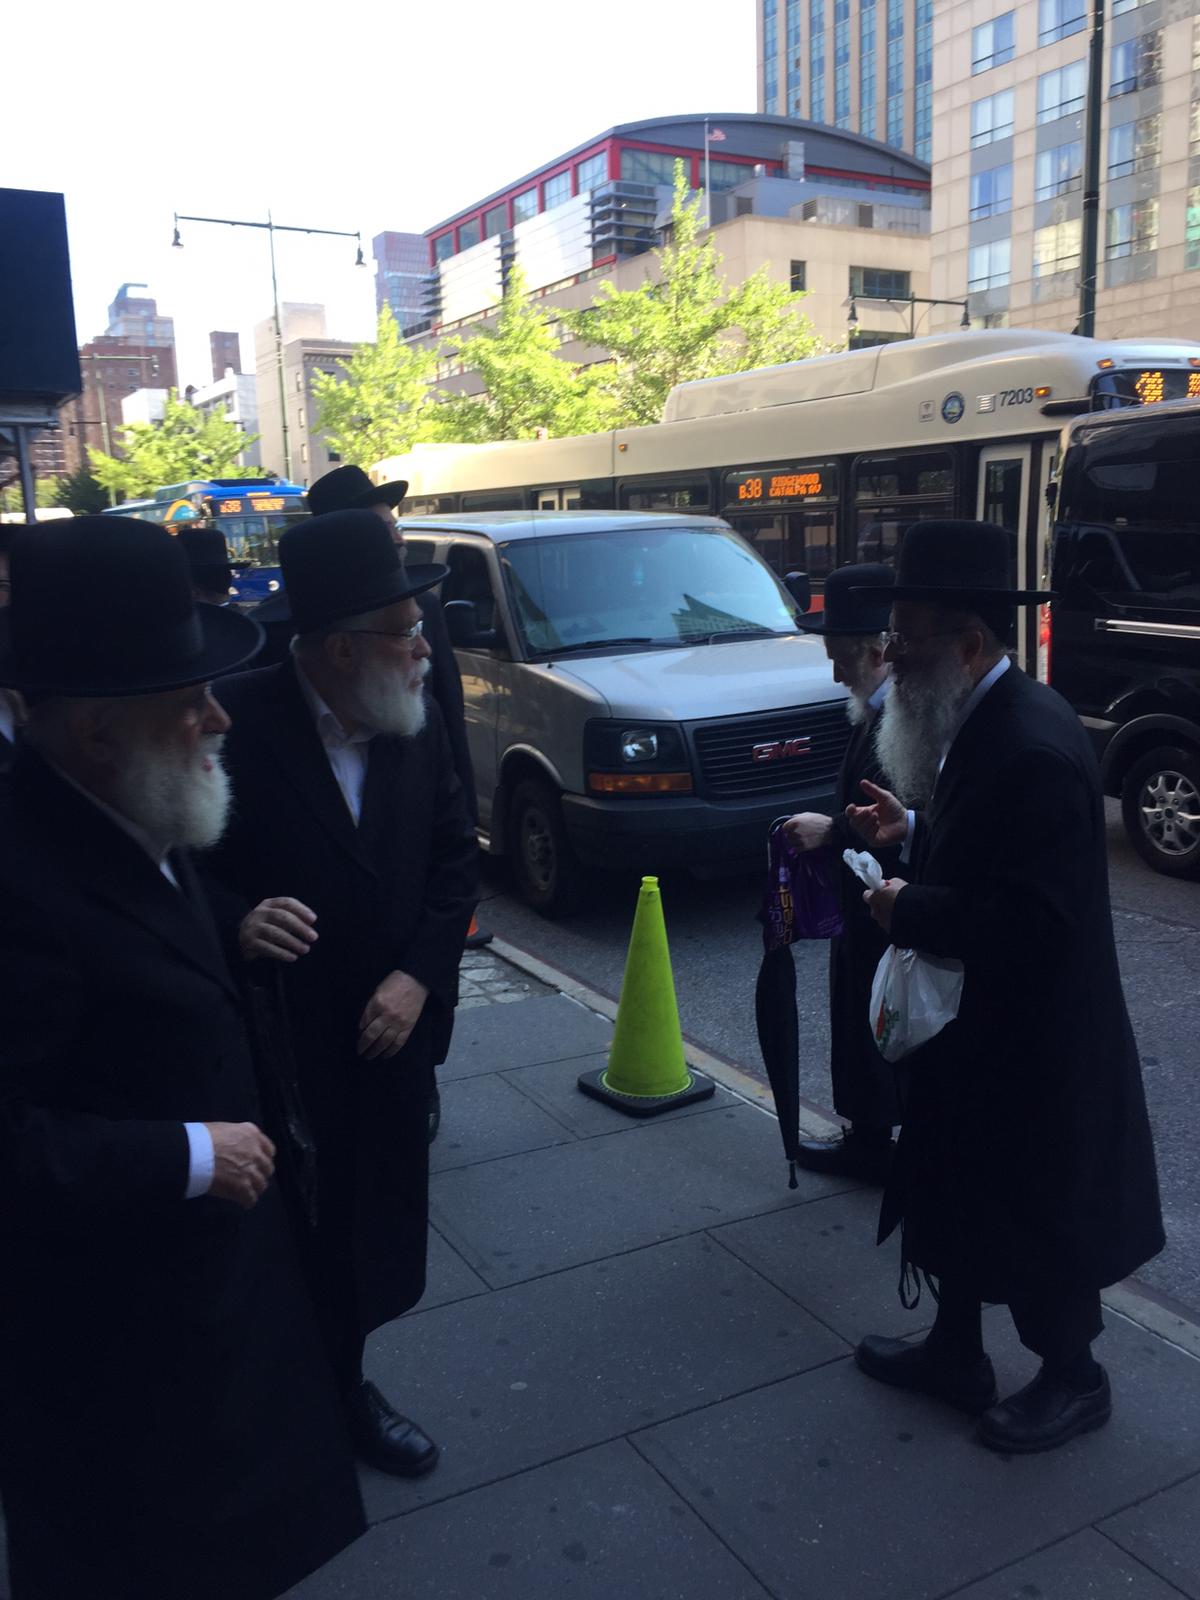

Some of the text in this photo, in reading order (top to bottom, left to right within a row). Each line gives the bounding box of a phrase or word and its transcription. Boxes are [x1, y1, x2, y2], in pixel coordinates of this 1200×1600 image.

[1000, 387, 1033, 406] 7203
[739, 479, 762, 499] B38
[772, 472, 819, 487] RIDGEWOOD
[752, 737, 811, 762] GMC
